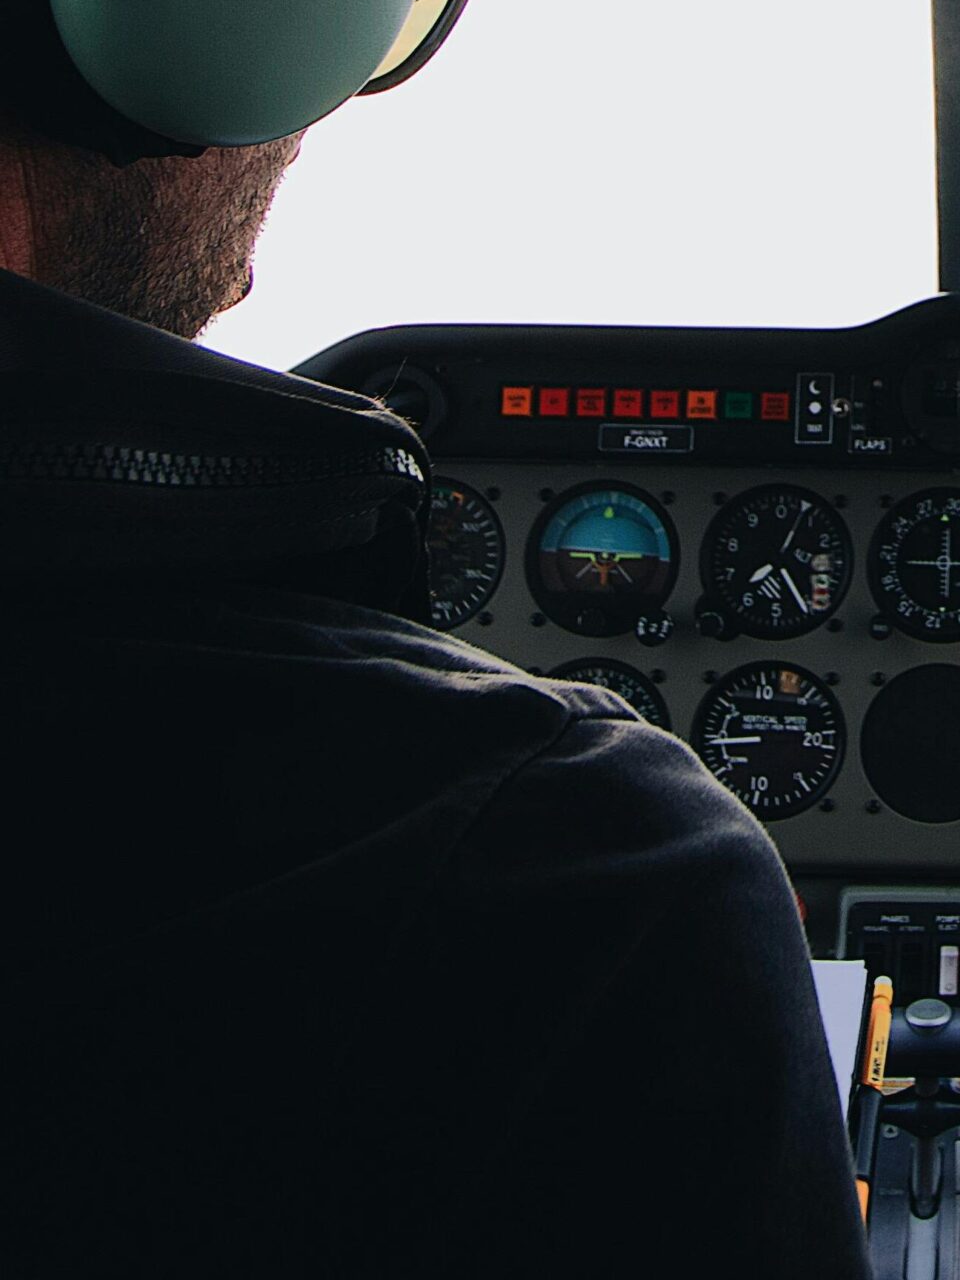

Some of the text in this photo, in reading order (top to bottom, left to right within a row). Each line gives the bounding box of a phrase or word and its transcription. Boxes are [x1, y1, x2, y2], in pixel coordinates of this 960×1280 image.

[854, 439, 886, 450] FLAPS
[727, 537, 739, 552] 8
[819, 532, 830, 548] 2
[742, 592, 754, 607] 6
[771, 603, 782, 618] 5
[756, 685, 774, 700] 10
[803, 732, 823, 747] 20
[751, 776, 768, 791] 10
